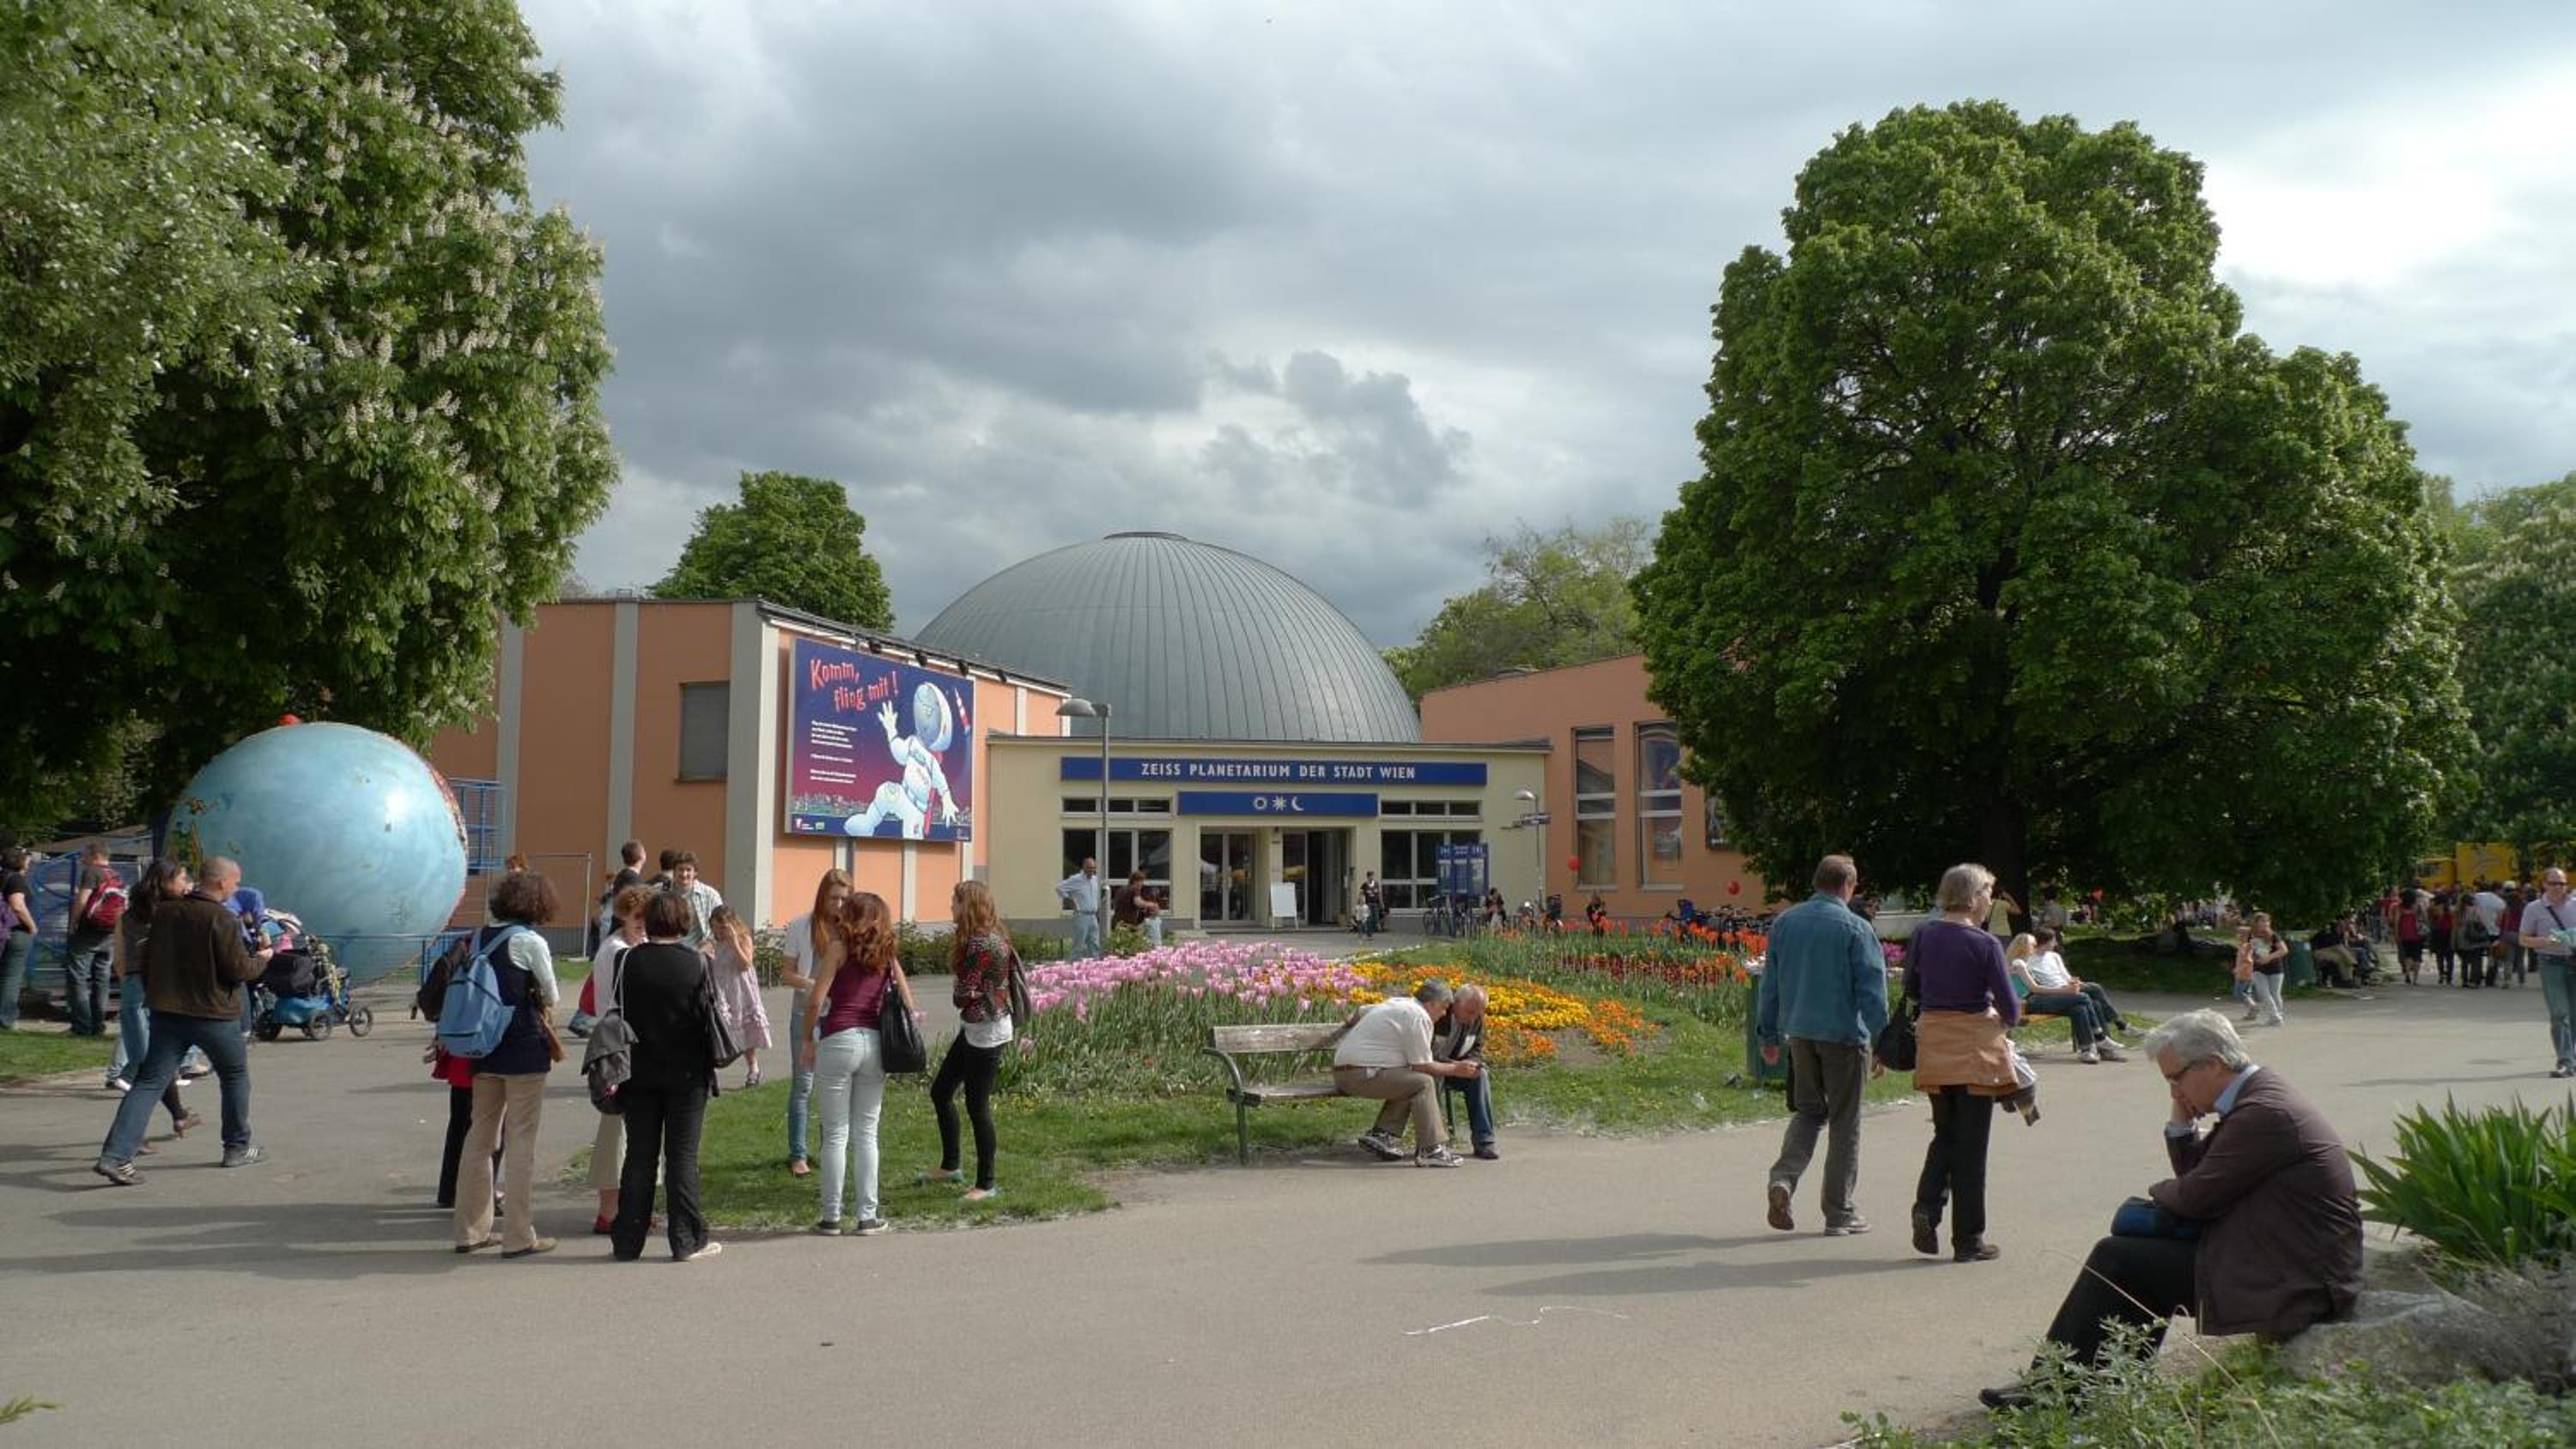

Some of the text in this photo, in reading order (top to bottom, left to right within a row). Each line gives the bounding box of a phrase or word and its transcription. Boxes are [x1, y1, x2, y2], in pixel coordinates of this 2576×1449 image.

[810, 658, 860, 691] Komm,
[1141, 763, 1416, 779] ZEISS PLANETARIUM DER STADT WIEN
